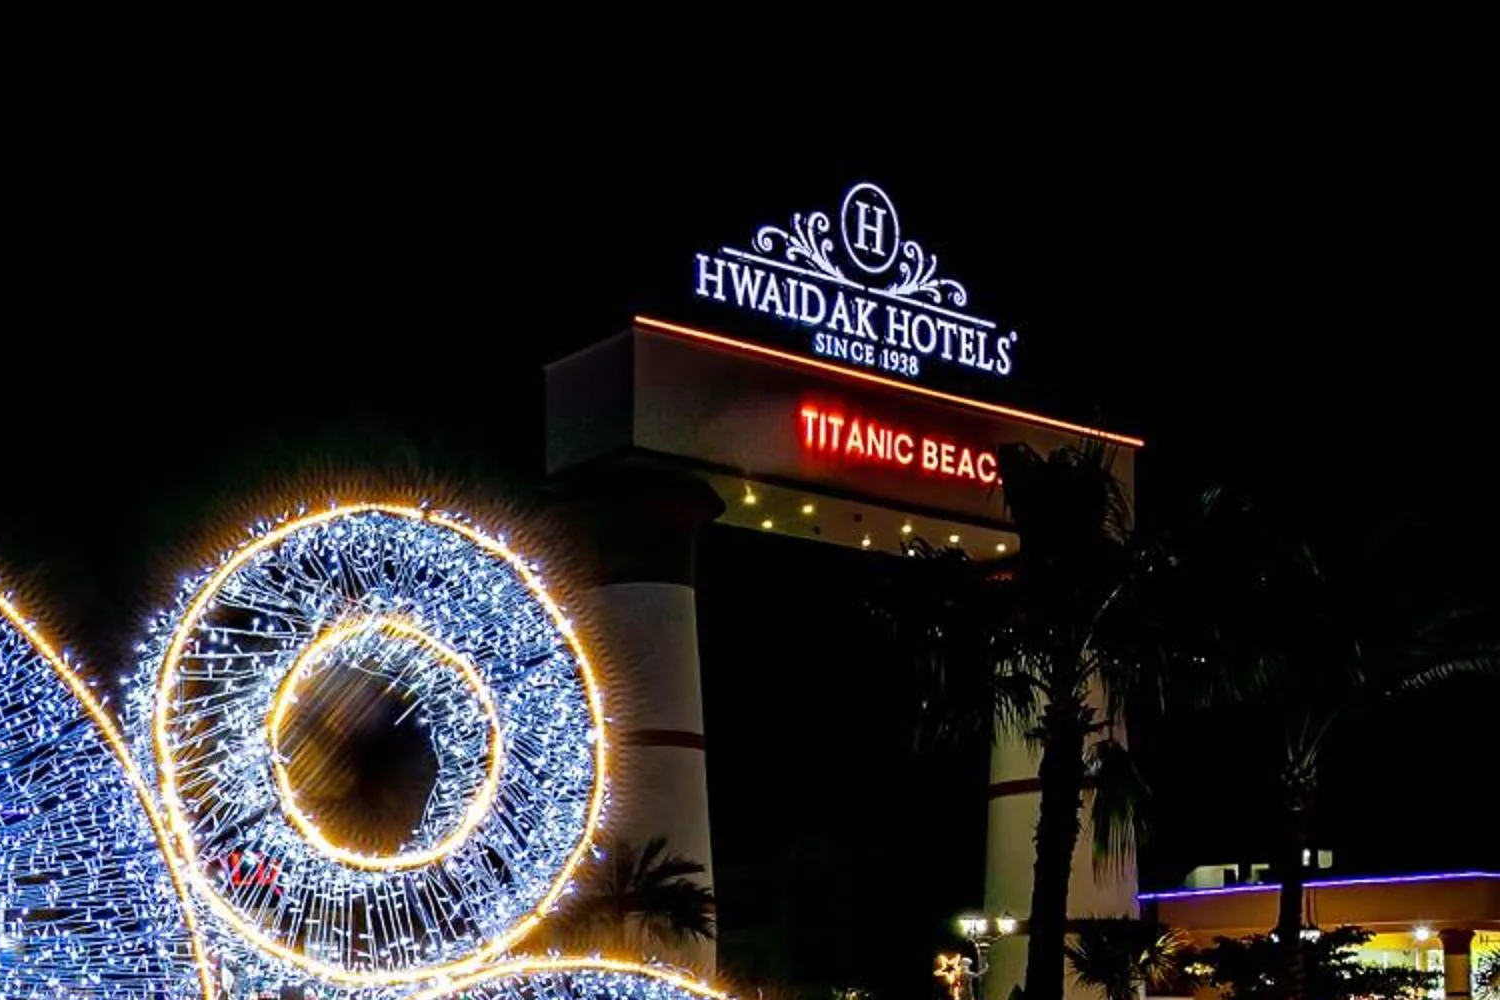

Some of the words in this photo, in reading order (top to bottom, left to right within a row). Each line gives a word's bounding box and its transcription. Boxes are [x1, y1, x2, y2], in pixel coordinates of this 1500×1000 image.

[854, 200, 887, 256] H
[696, 254, 879, 341] HWAIDAK
[814, 332, 876, 365] SINCE
[881, 349, 920, 377] 1938
[800, 407, 914, 465] TITANIC
[921, 437, 1004, 486] BEAC
